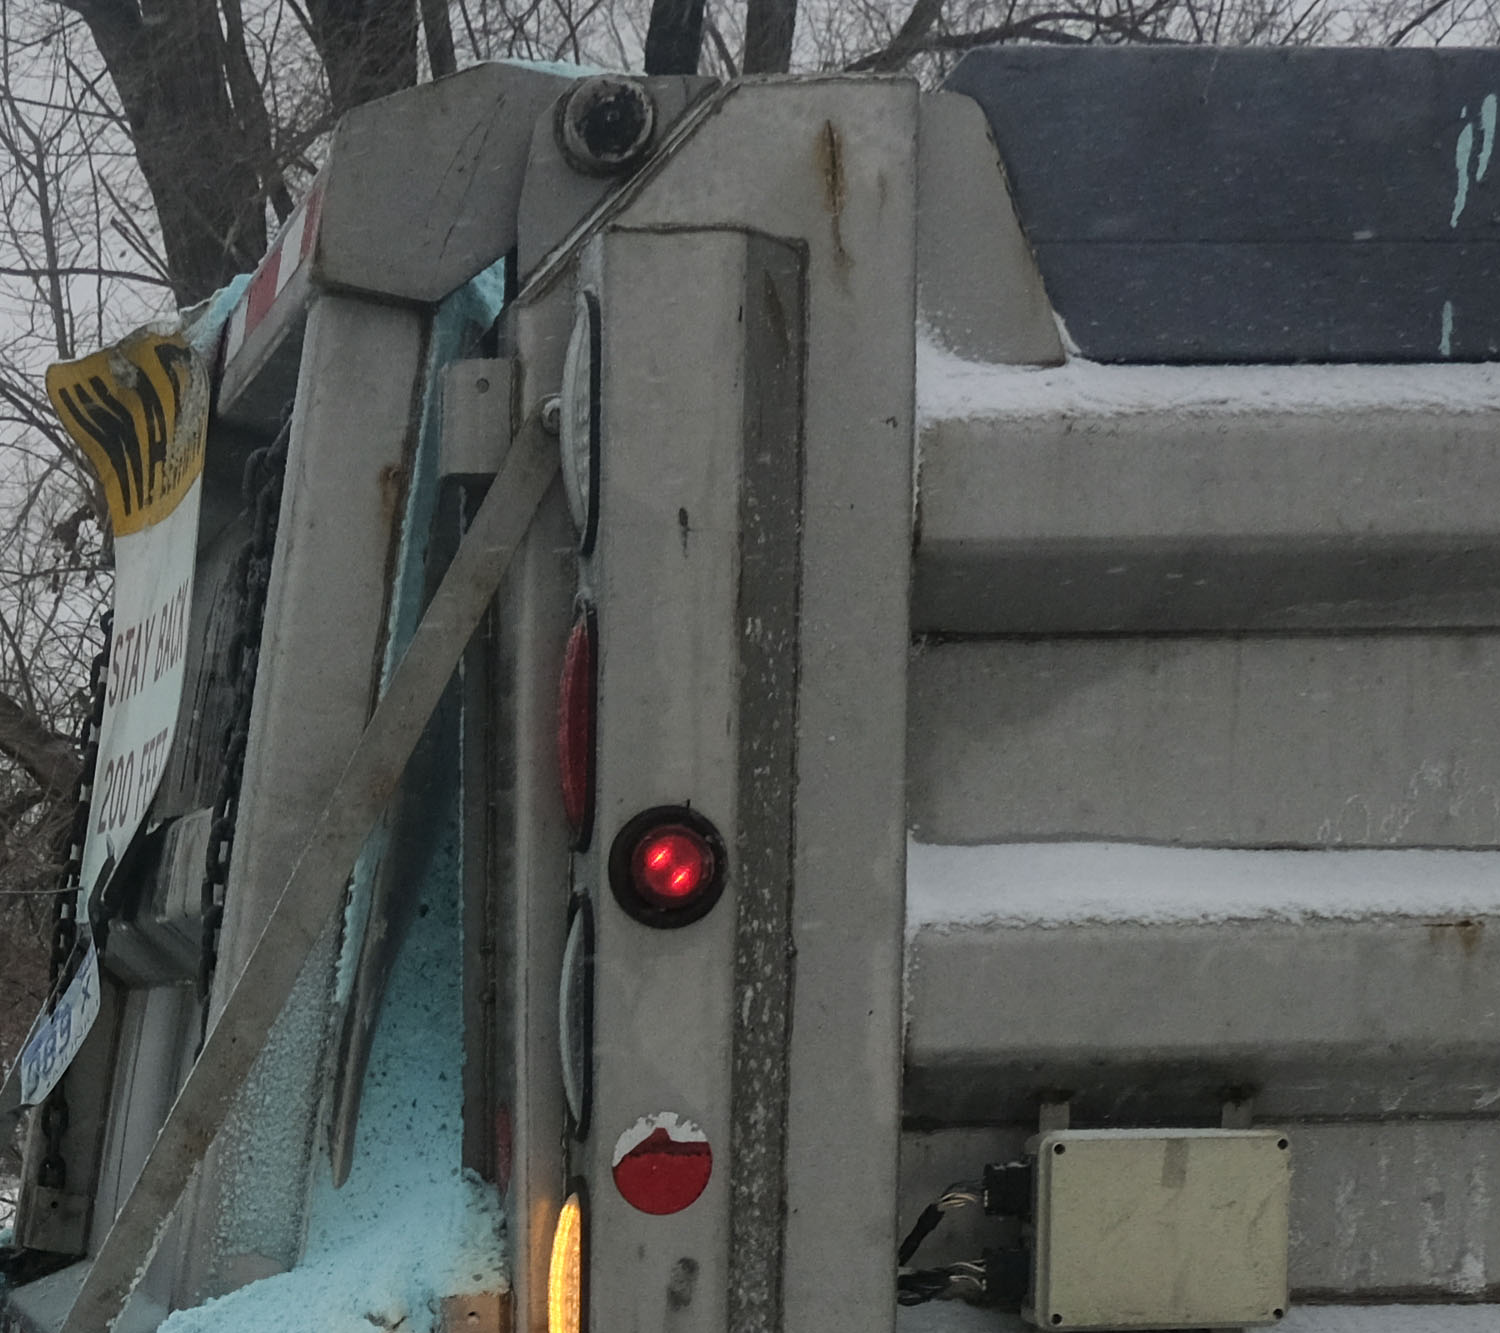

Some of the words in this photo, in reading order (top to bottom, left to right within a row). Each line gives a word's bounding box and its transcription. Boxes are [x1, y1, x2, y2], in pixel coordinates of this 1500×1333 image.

[108, 613, 156, 708] STAY
[153, 577, 189, 683] BACK
[97, 750, 134, 835] 200
[134, 726, 169, 821] FEET
